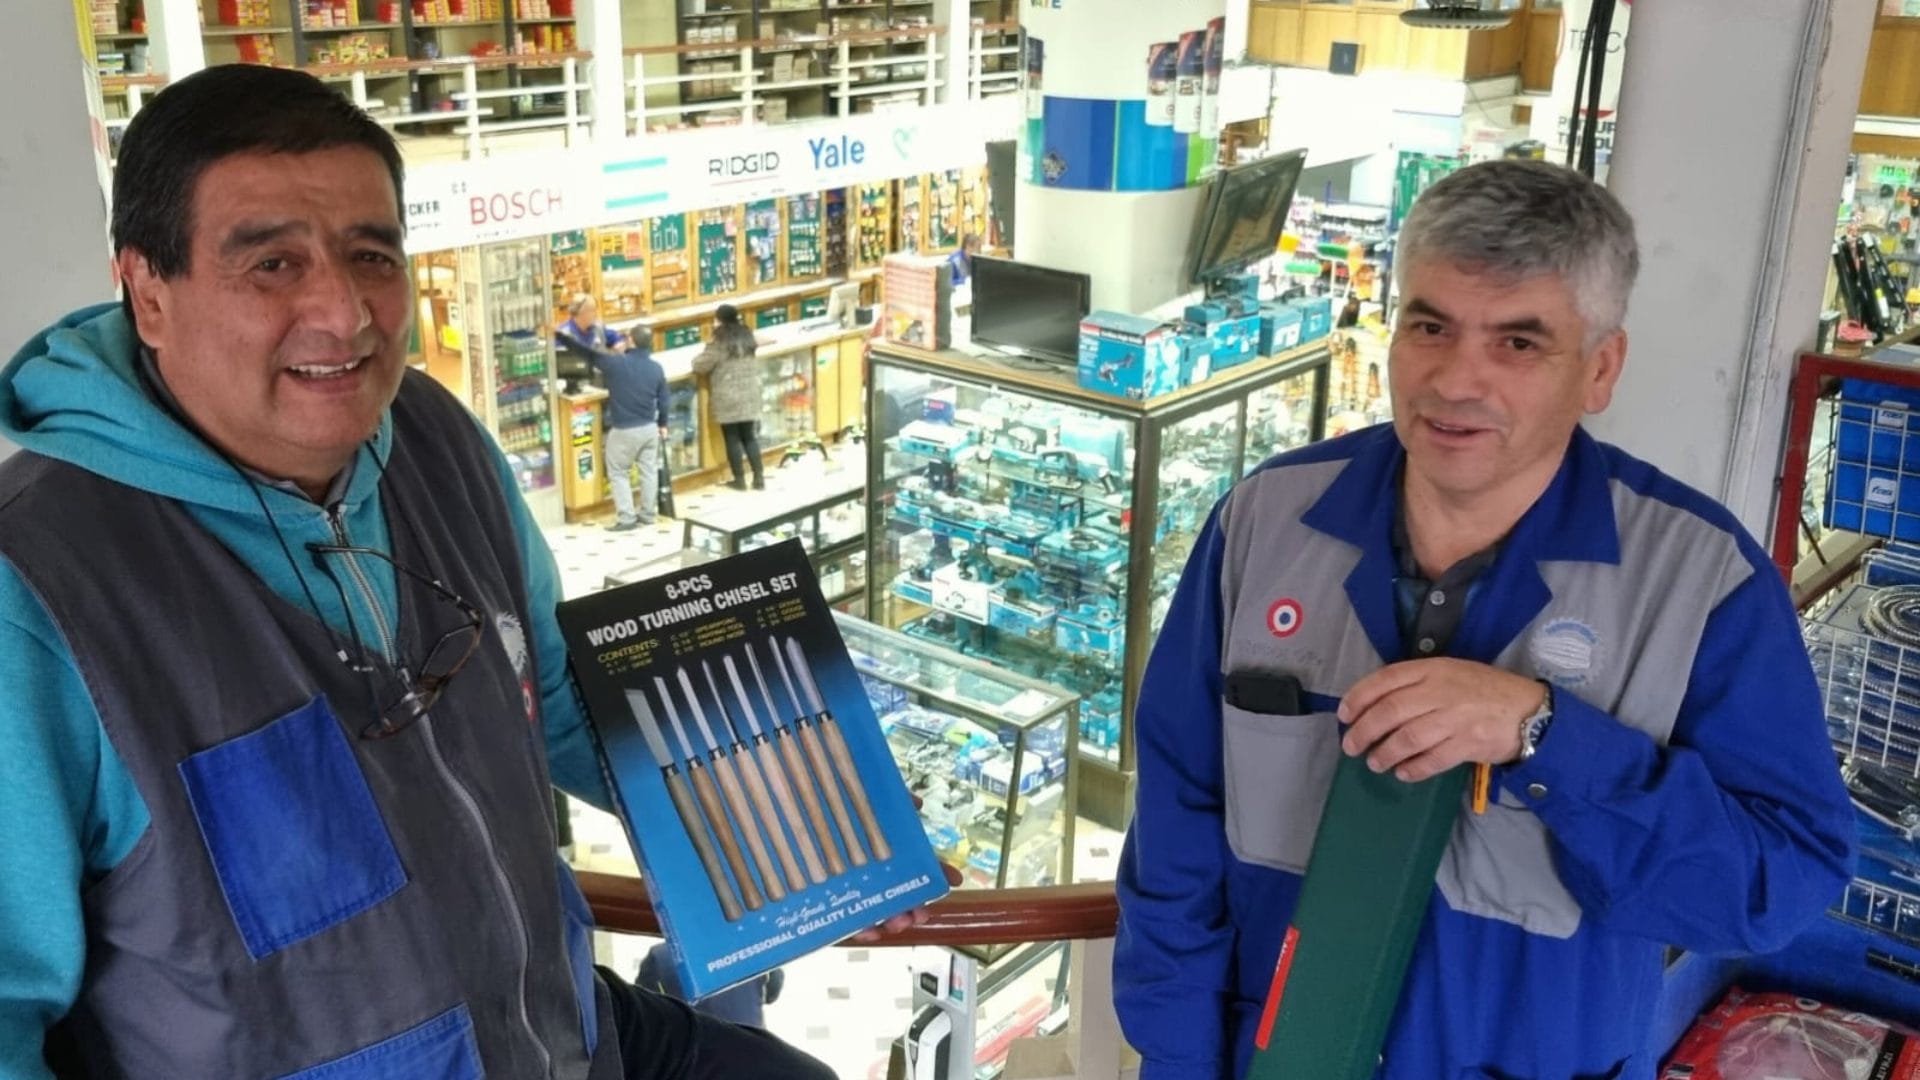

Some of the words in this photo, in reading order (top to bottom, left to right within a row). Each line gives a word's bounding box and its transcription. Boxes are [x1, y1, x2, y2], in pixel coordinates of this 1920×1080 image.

[709, 151, 780, 176] RIDGID
[809, 135, 865, 170] Yale
[470, 188, 562, 225] BOSCH
[665, 573, 713, 599] 8-PCS
[586, 619, 638, 647] WOOD
[639, 597, 713, 631] TURNING
[714, 581, 770, 610] CHISEL
[770, 572, 799, 594] SET
[707, 929, 796, 972] PROFESSIONAL
[797, 910, 846, 935] QUALITY
[848, 893, 884, 915] LATHE
[885, 875, 930, 900] CHISELS
